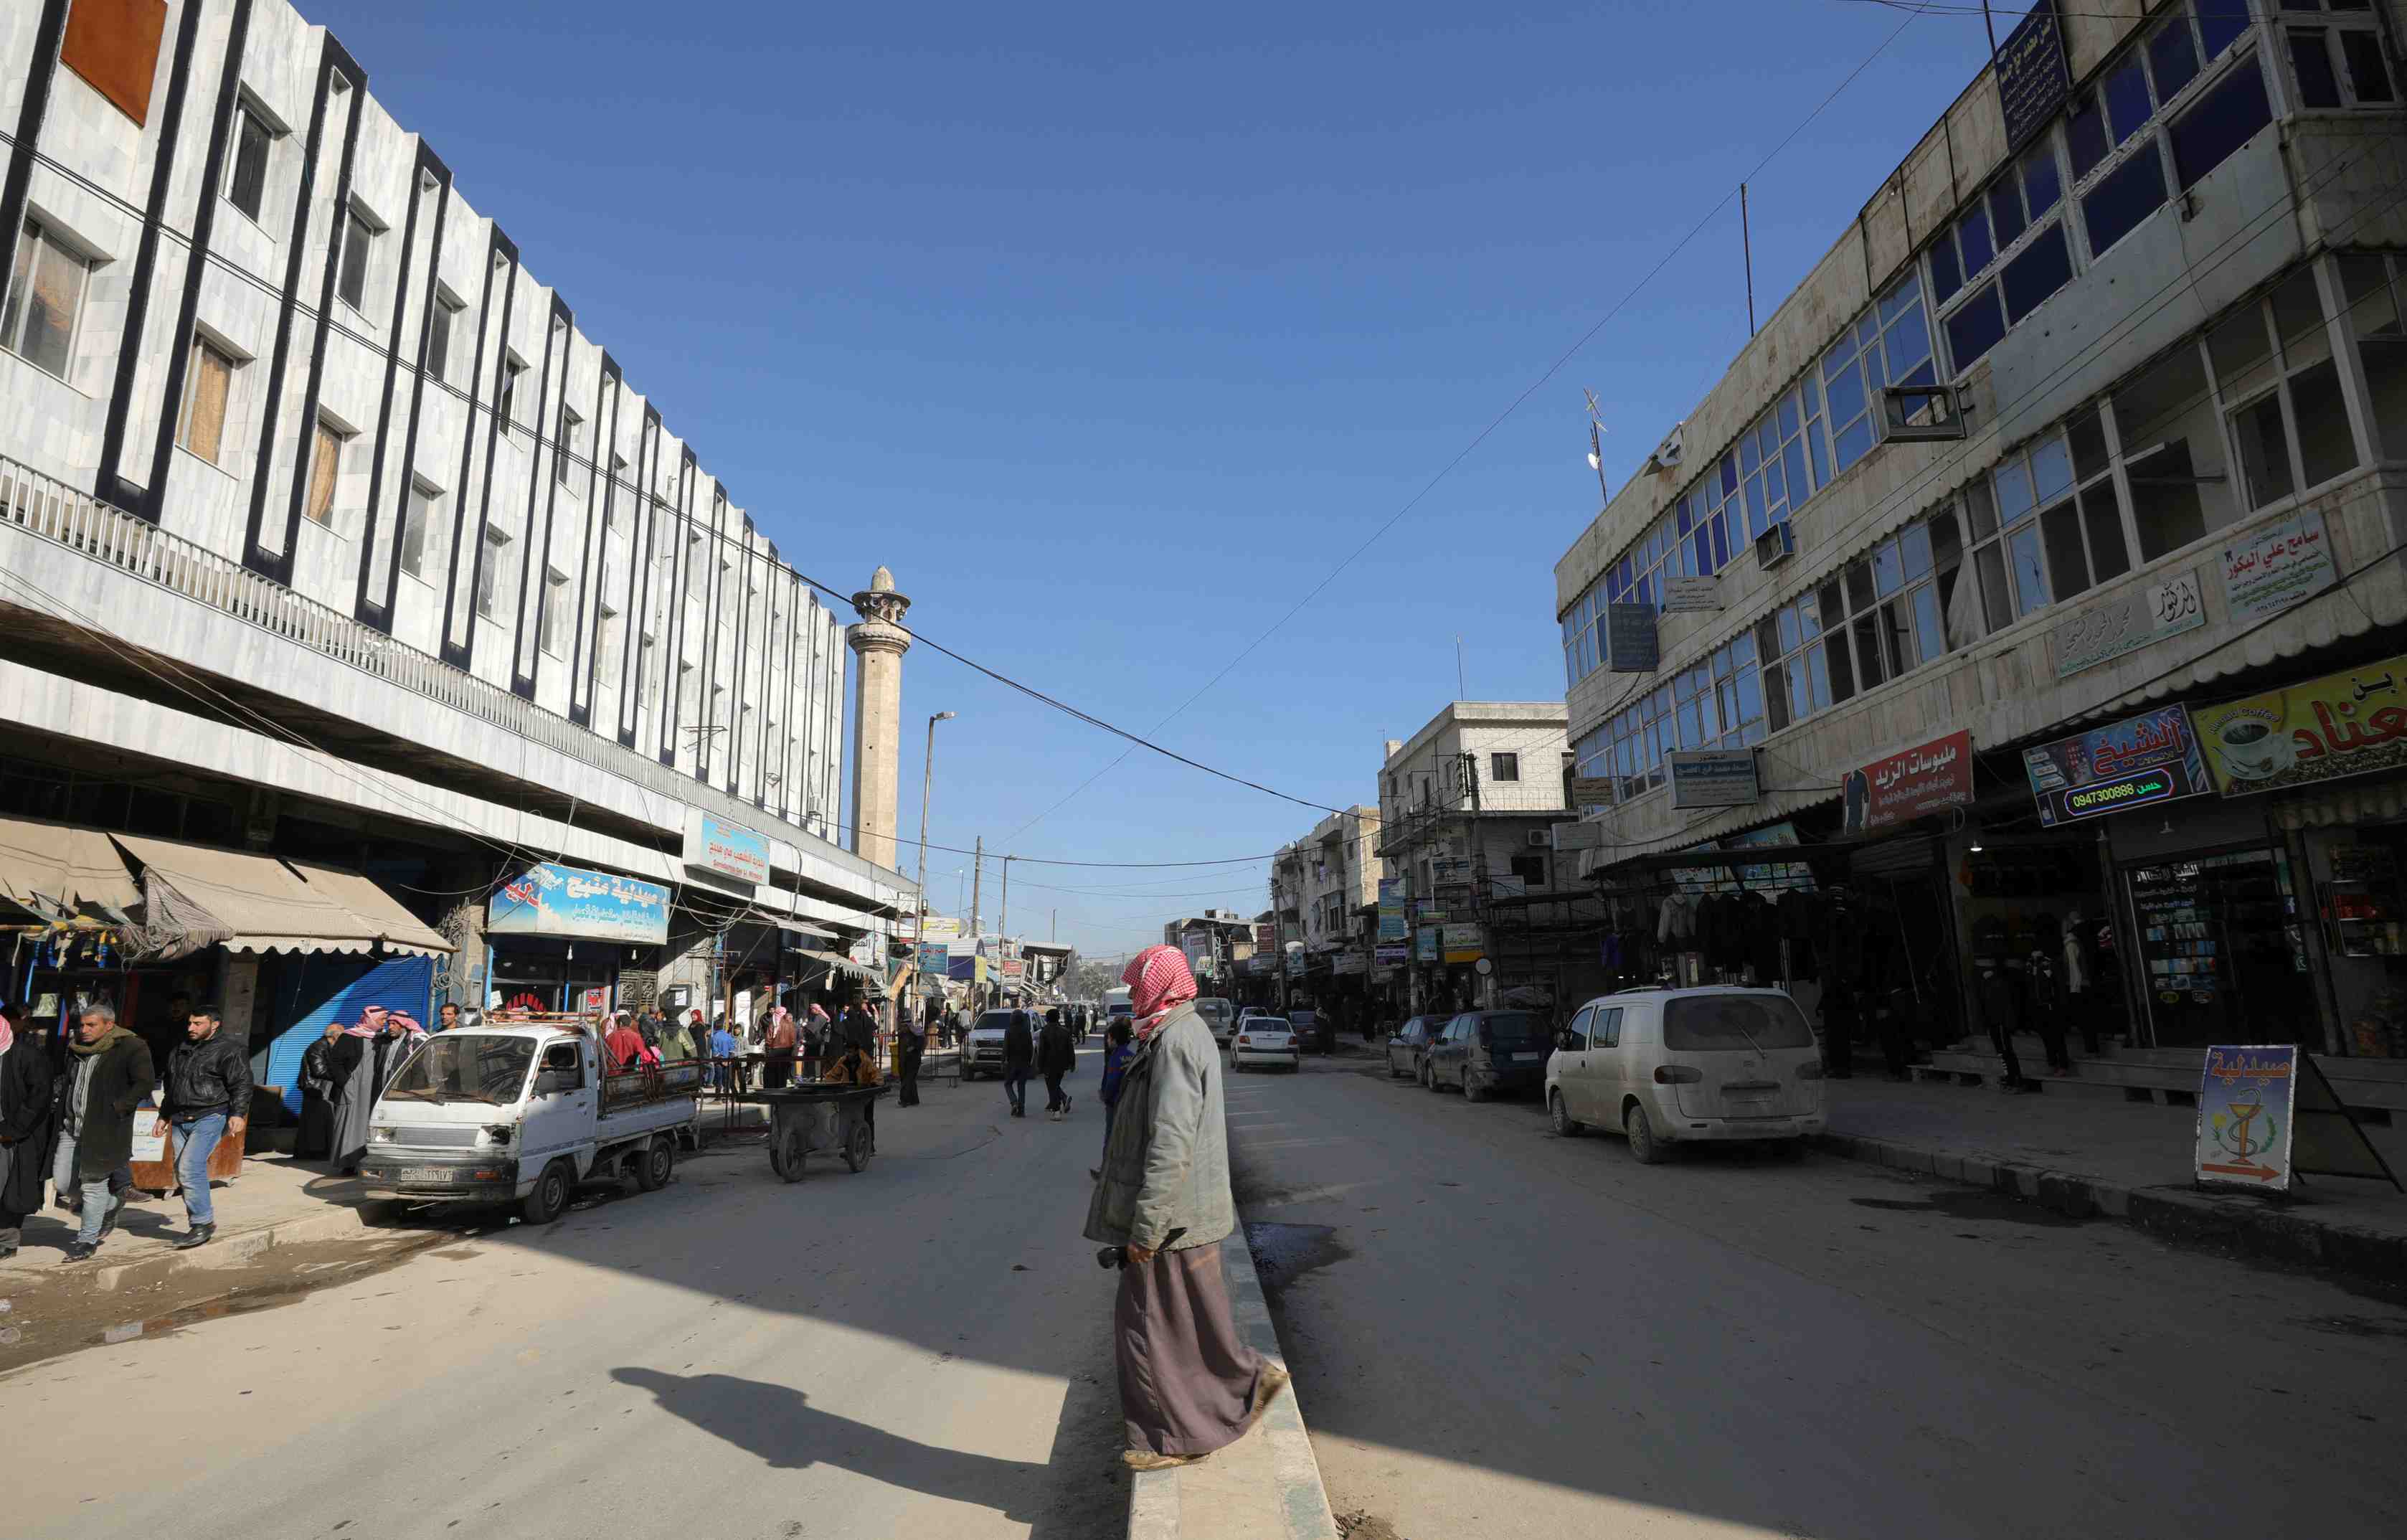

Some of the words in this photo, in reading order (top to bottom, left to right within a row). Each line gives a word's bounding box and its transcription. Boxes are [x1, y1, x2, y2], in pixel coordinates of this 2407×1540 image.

[2263, 544, 2284, 568] علي
[2287, 532, 2319, 556] سامح
[2350, 671, 2394, 701] بن
[1909, 745, 1957, 774] ملبوسات
[2094, 715, 2185, 775] الشيخ
[1876, 758, 1905, 790] الزيد
[2136, 781, 2164, 795] حسن
[2073, 783, 2135, 808] 0947300888
[611, 877, 658, 908] صيدلية
[2210, 1051, 2290, 1086] صيدلية
